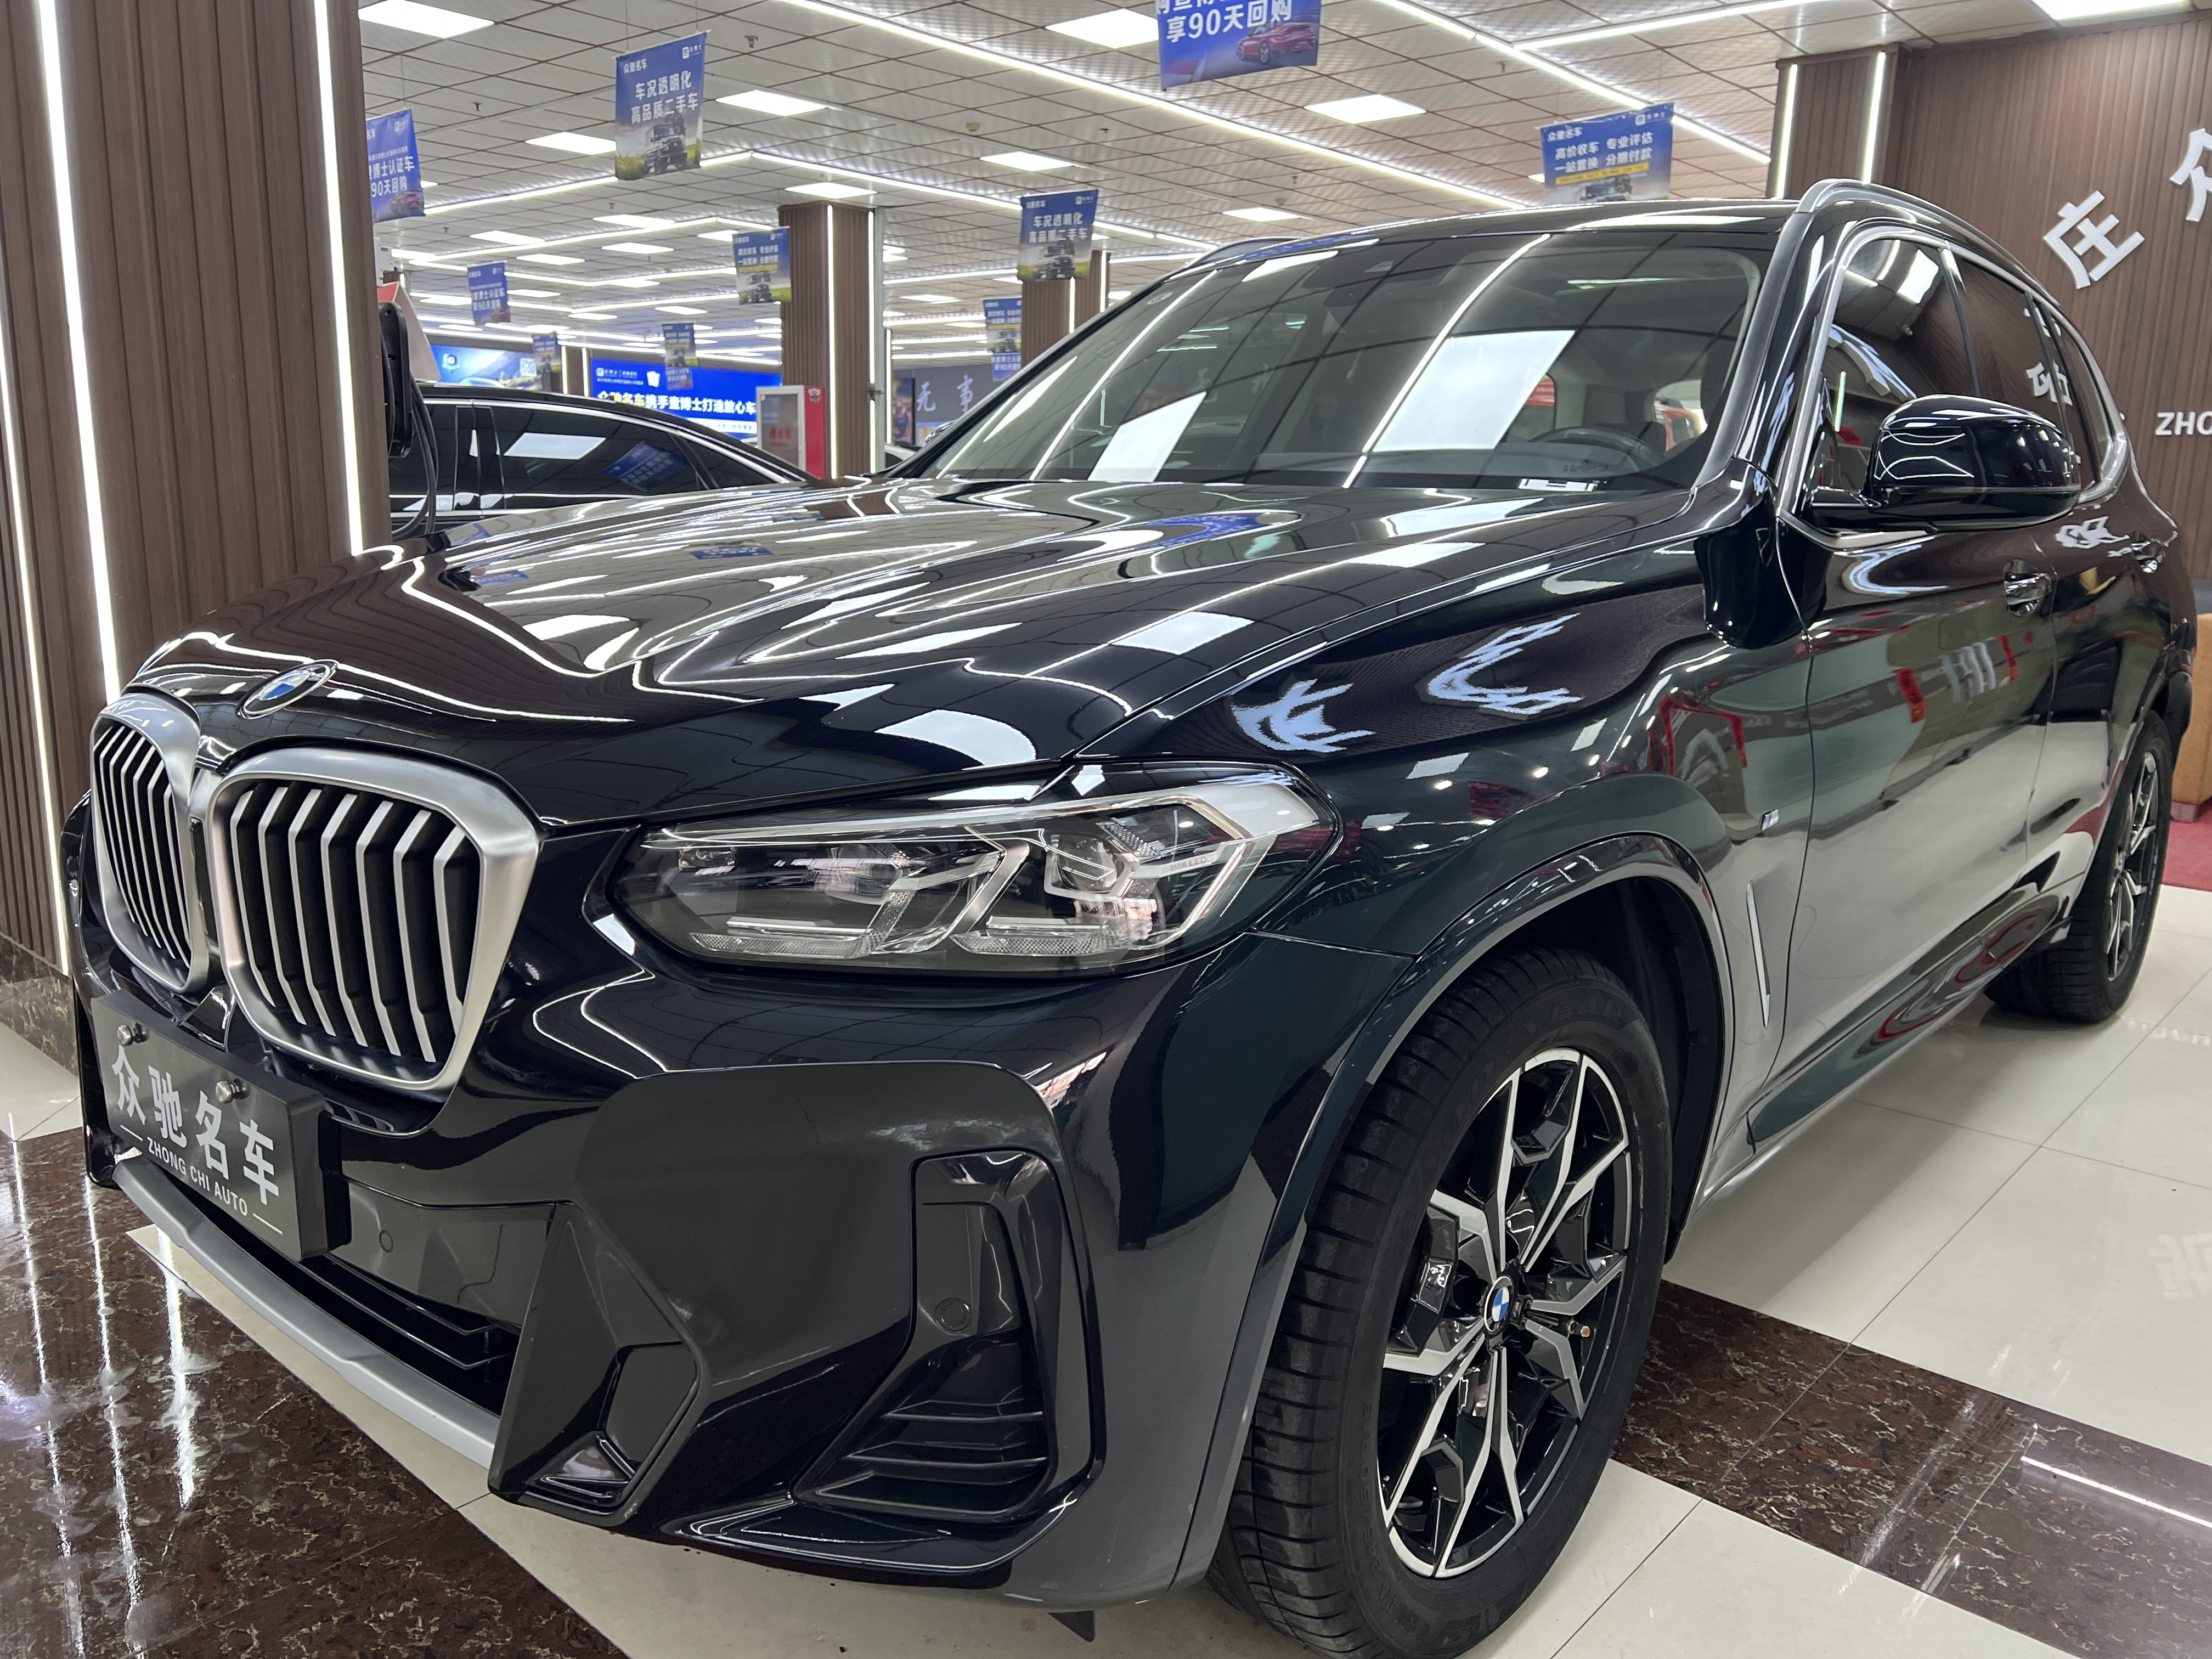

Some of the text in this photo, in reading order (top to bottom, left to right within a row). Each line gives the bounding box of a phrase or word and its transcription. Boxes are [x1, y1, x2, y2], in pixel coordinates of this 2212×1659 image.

[1166, 0, 1293, 43] 享90天回购
[635, 70, 691, 100] 车况透明化
[631, 93, 698, 124] 高品质二手车
[1555, 131, 1654, 160] 高价收车 专业评估
[1605, 147, 1652, 166] 分期付款
[2155, 411, 2212, 436] ZHO
[1170, 856, 1207, 872] BMW LED
[111, 1045, 280, 1205] 众驰名车
[146, 1137, 248, 1216] ZHONG CHI AUTO
